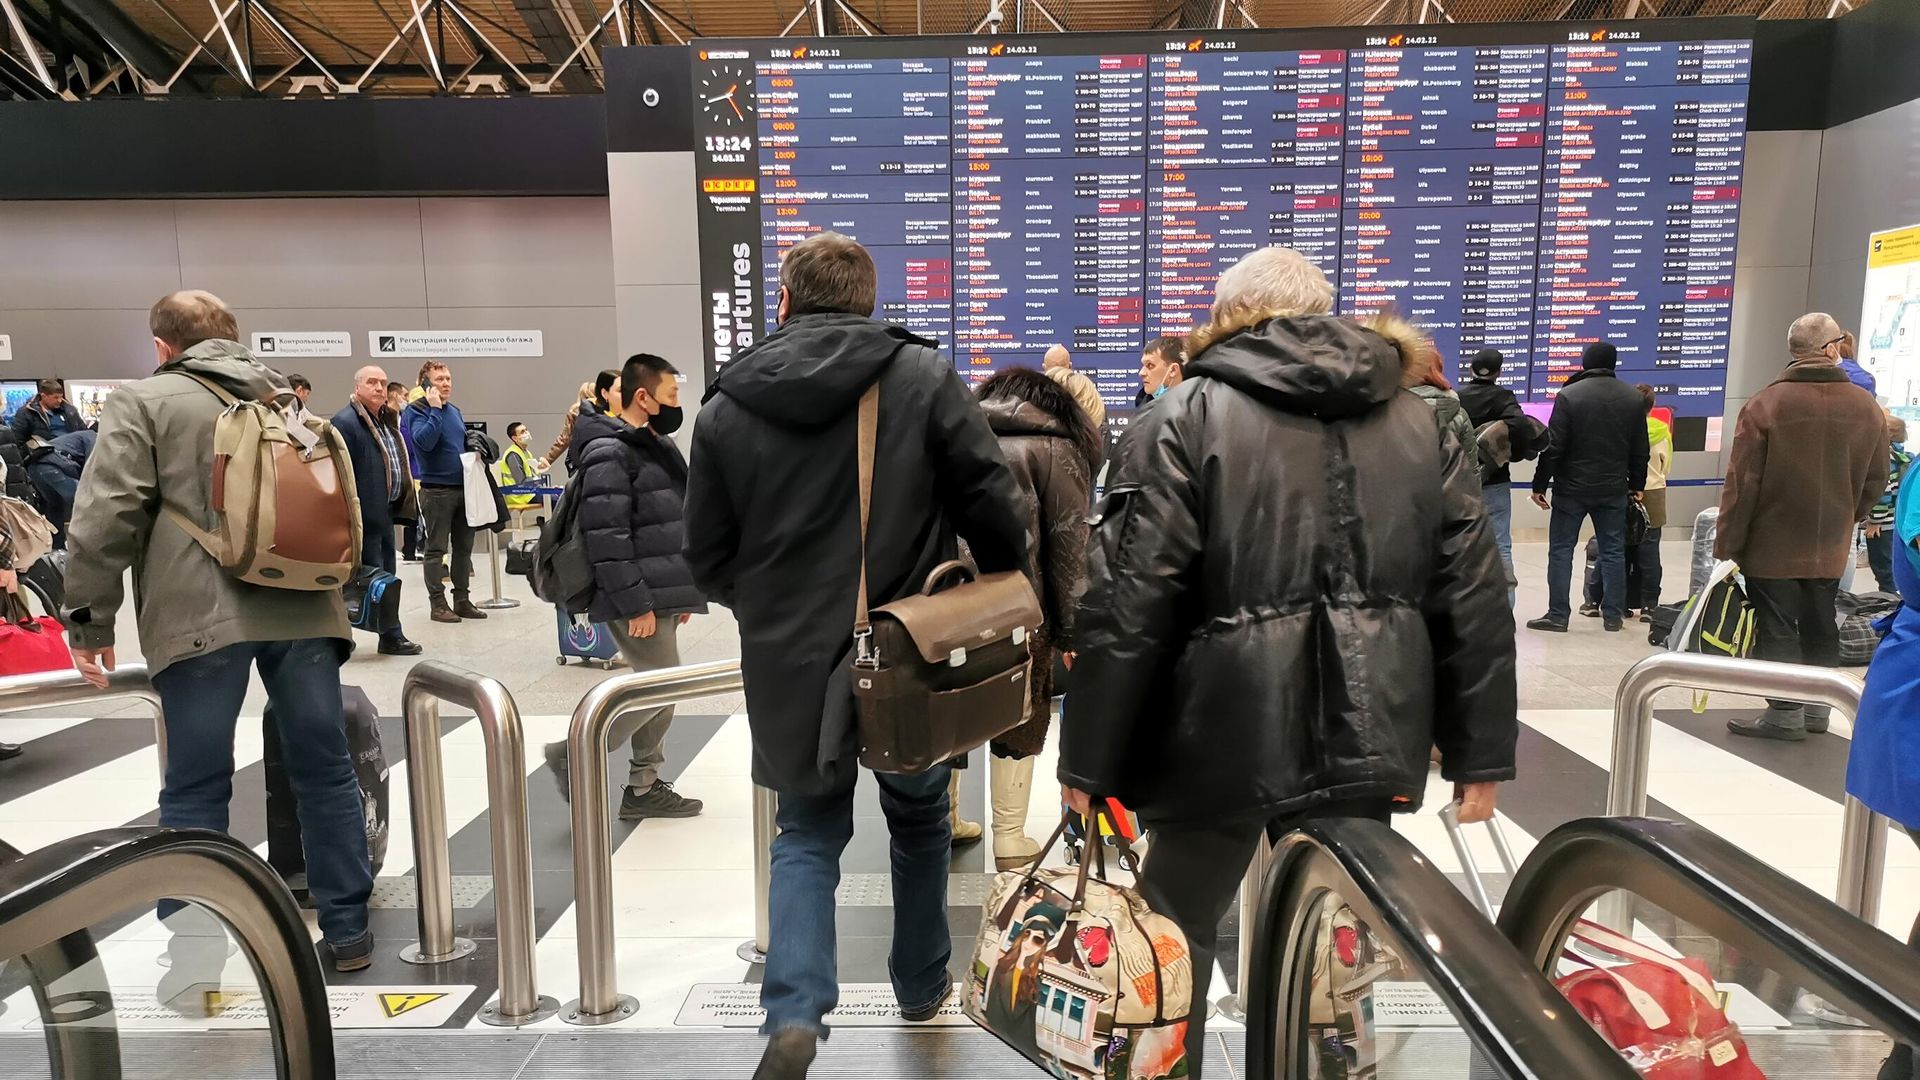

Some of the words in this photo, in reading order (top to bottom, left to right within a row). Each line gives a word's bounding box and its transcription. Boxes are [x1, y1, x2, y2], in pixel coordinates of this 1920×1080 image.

[1609, 31, 1640, 39] 24.02.22
[810, 49, 840, 57] 24.02.22
[705, 136, 752, 151] 13:24
[712, 154, 745, 162] 24.02.22
[1361, 154, 1383, 162] 19:00
[1163, 173, 1185, 181] 17:00
[1359, 211, 1381, 219] 20:00
[732, 242, 753, 352] artures
[712, 292, 731, 372] леты
[399, 337, 447, 345] Регистрация
[449, 337, 504, 345] негабаритного
